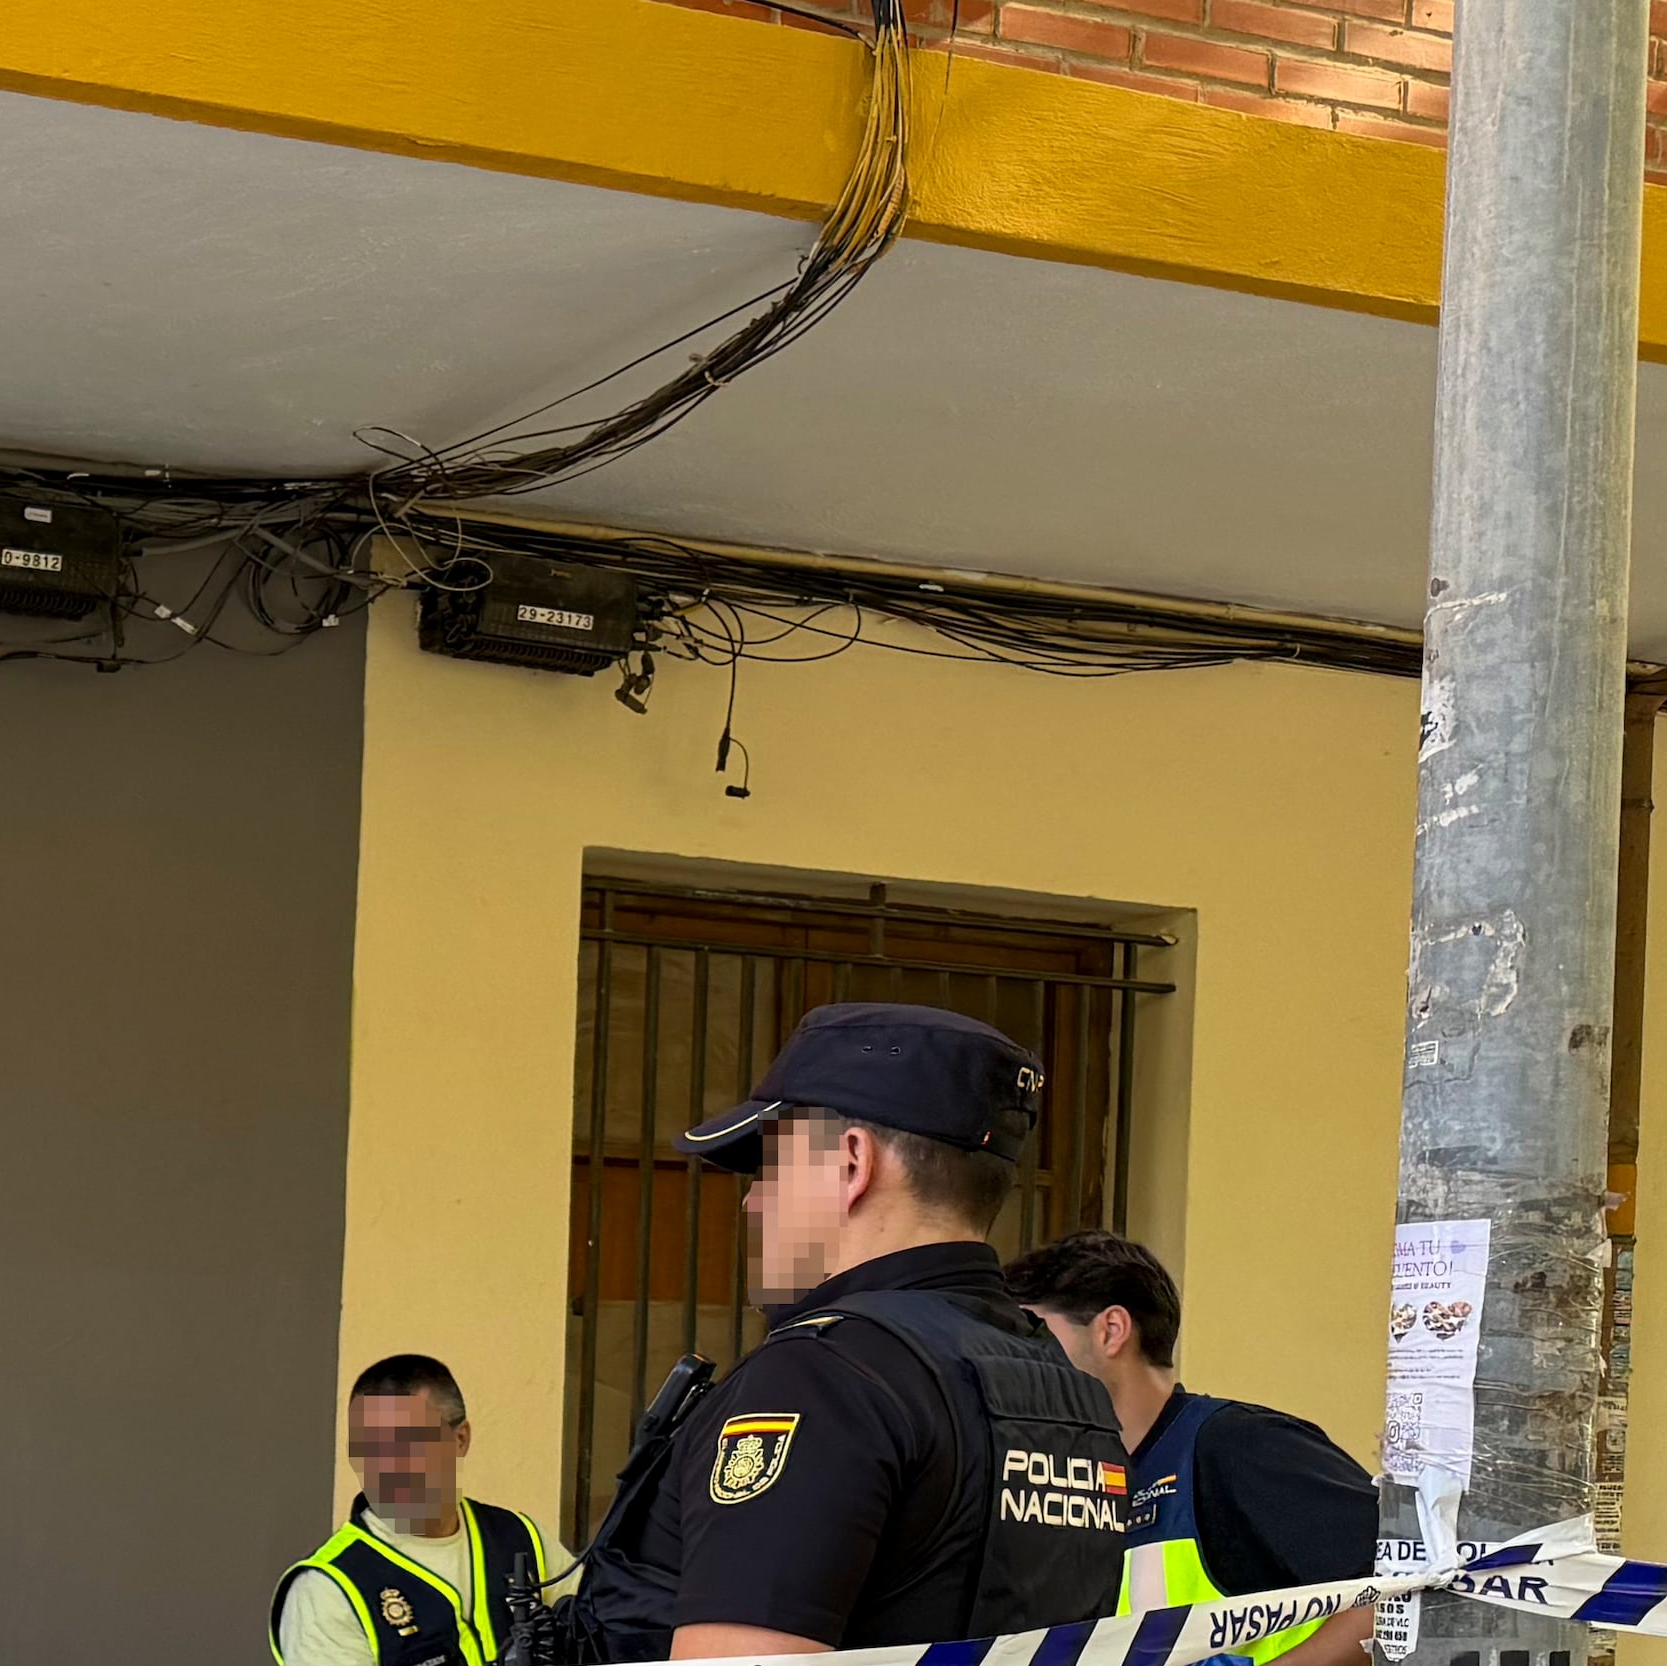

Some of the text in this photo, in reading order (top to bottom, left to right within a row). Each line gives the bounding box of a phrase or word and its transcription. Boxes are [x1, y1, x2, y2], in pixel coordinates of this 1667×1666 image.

[4, 551, 60, 570] 0-9812
[518, 606, 593, 629] 29-23173
[1002, 1448, 1106, 1489] POLICIA
[1000, 1487, 1126, 1534] NACIONAL
[1398, 1541, 1427, 1561] DE
[1210, 1600, 1298, 1649] PASAR
